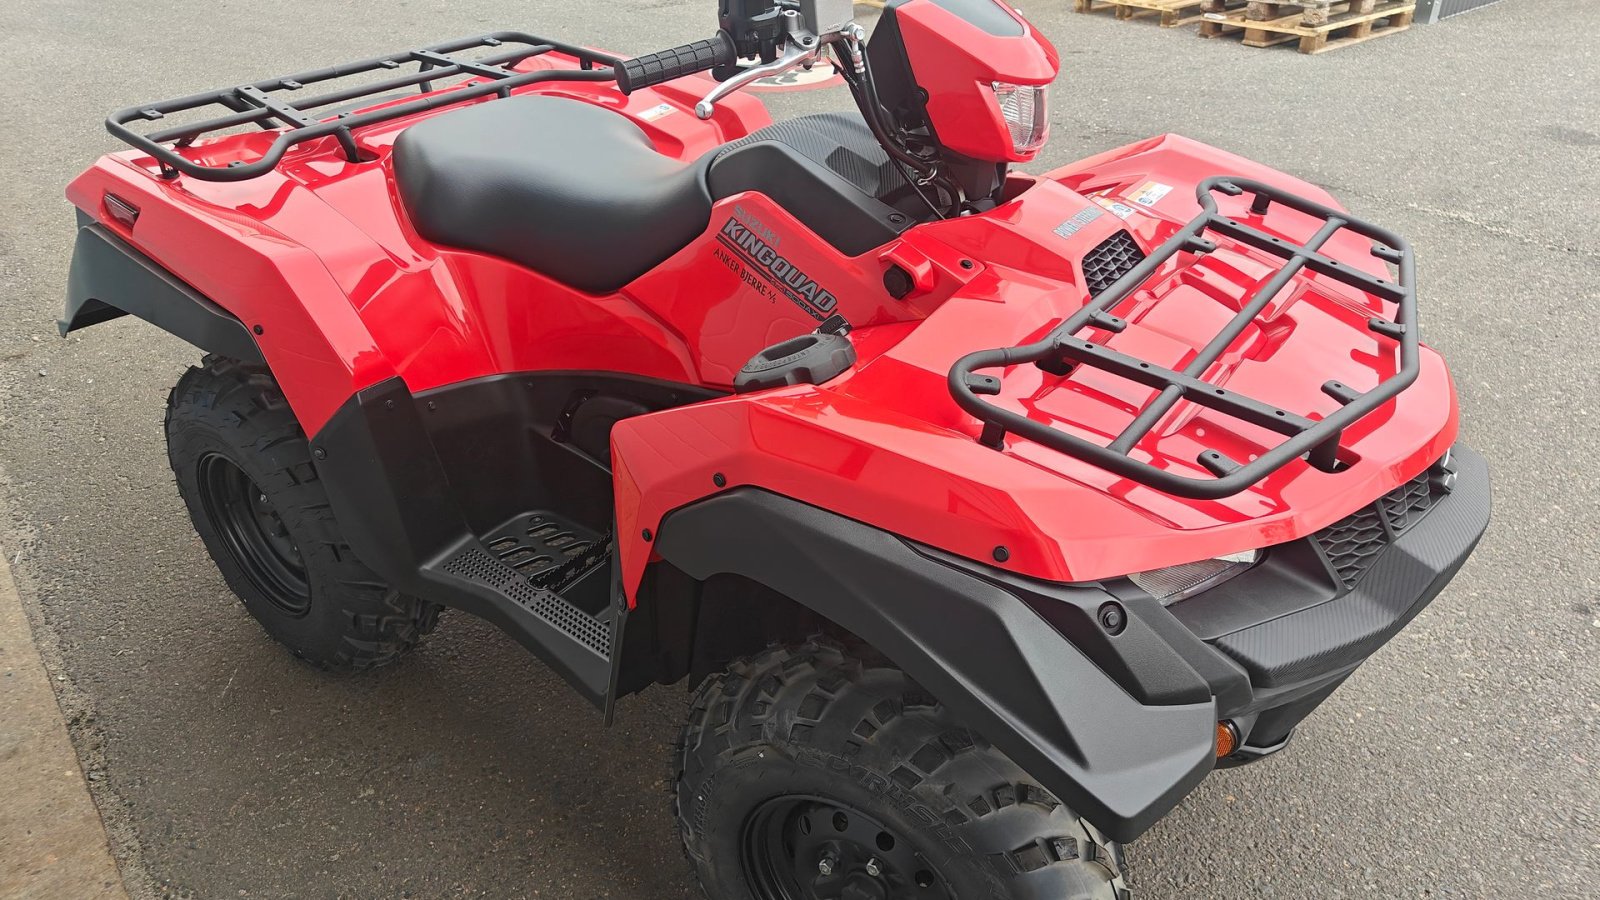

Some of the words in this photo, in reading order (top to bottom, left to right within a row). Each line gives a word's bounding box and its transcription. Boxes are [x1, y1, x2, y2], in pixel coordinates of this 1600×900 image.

[733, 204, 781, 248] SUZUKI
[713, 248, 740, 275] ANKER
[740, 269, 767, 296] BJERRE
[720, 216, 837, 313] KINGQUAD
